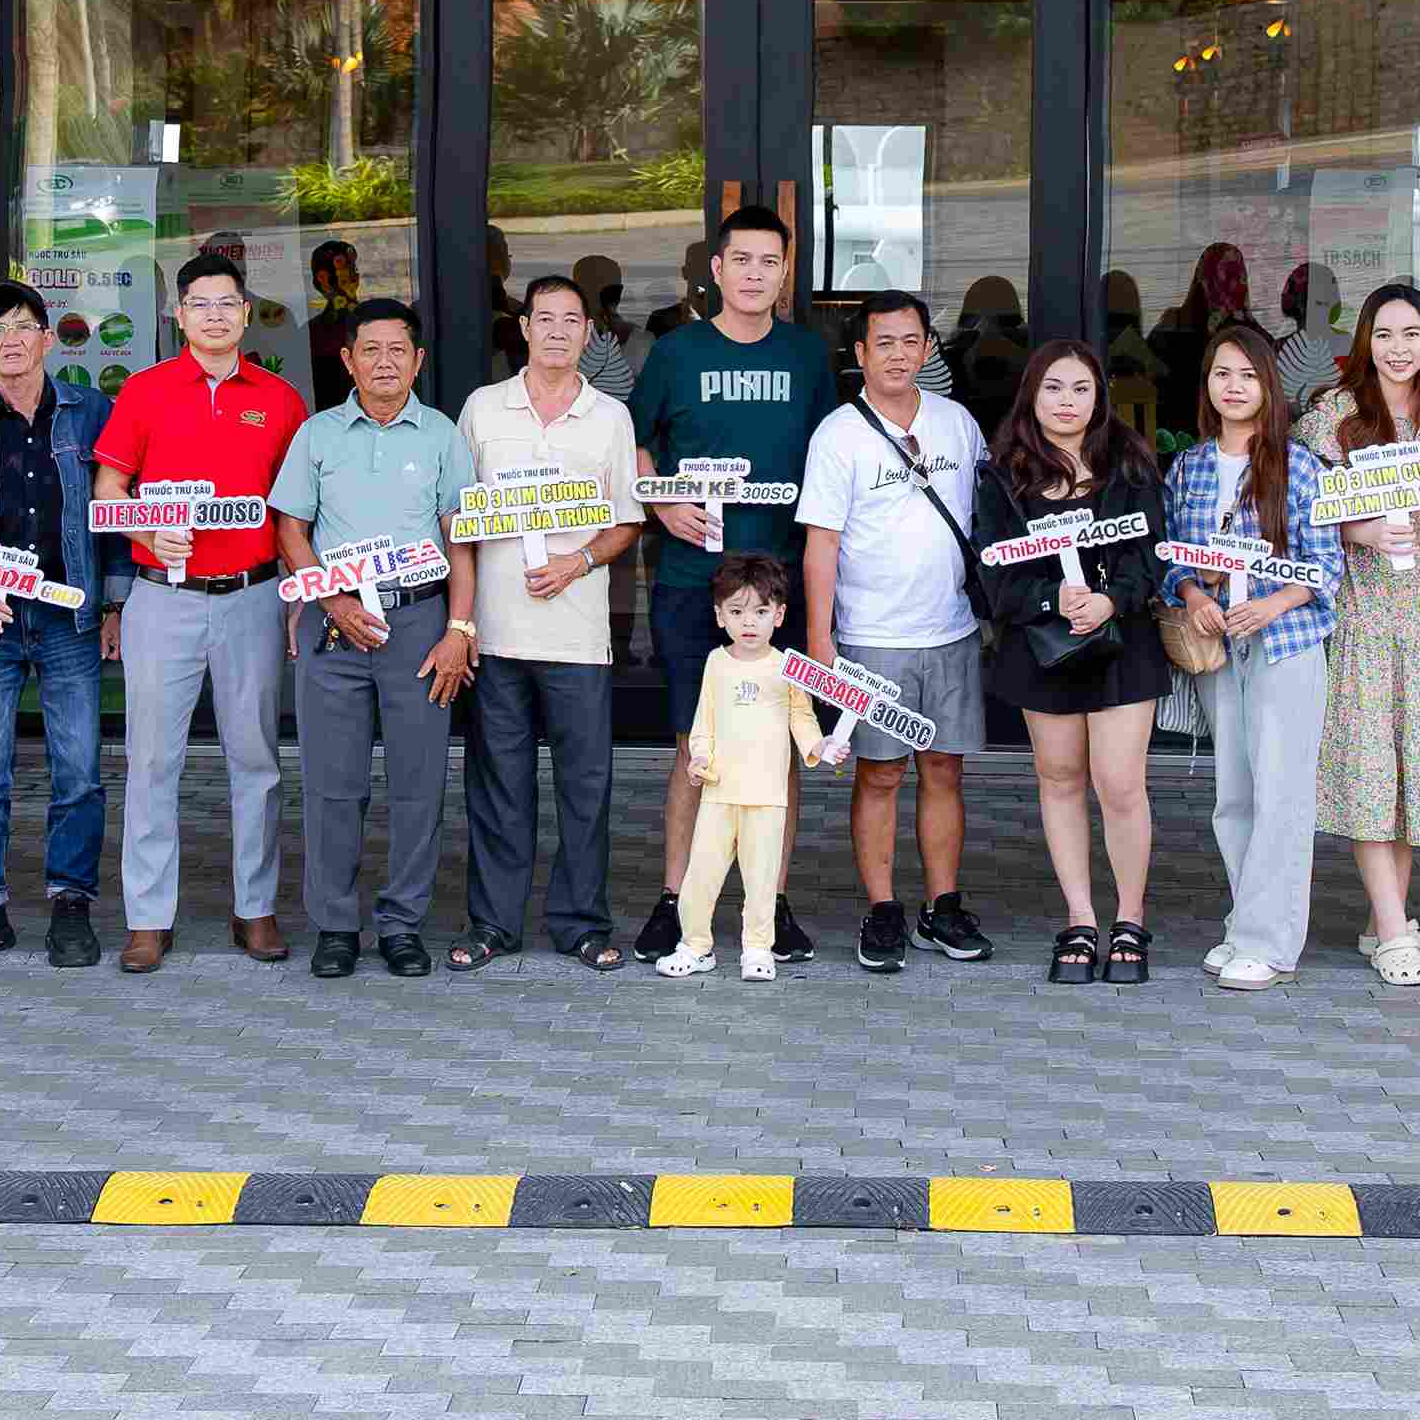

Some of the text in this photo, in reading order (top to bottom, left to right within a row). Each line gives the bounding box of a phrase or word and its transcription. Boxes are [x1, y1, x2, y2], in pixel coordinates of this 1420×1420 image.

[701, 369, 792, 403] PUMA
[143, 482, 172, 497] THUỐC
[174, 482, 191, 496] TRỪ
[465, 479, 598, 513] BỘ 3 KIM CƯƠNG
[635, 473, 702, 497] CHIẾN
[741, 486, 794, 501] 300SC
[1323, 470, 1348, 497] BỘ
[1350, 471, 1363, 490] 3
[1364, 466, 1399, 488] KIM
[93, 500, 262, 527] DIETSACH 300SC
[455, 518, 480, 539] AN
[482, 510, 519, 535] TÂM
[555, 501, 612, 528] TRÚNG
[1314, 500, 1341, 521] AN
[1343, 492, 1382, 517] TÂM
[996, 516, 1147, 562] Thibifos 440EC
[403, 564, 448, 585] 400WP
[1171, 544, 1322, 585] Thibifos 440EC
[784, 653, 933, 748] DIETSACH 300SC
